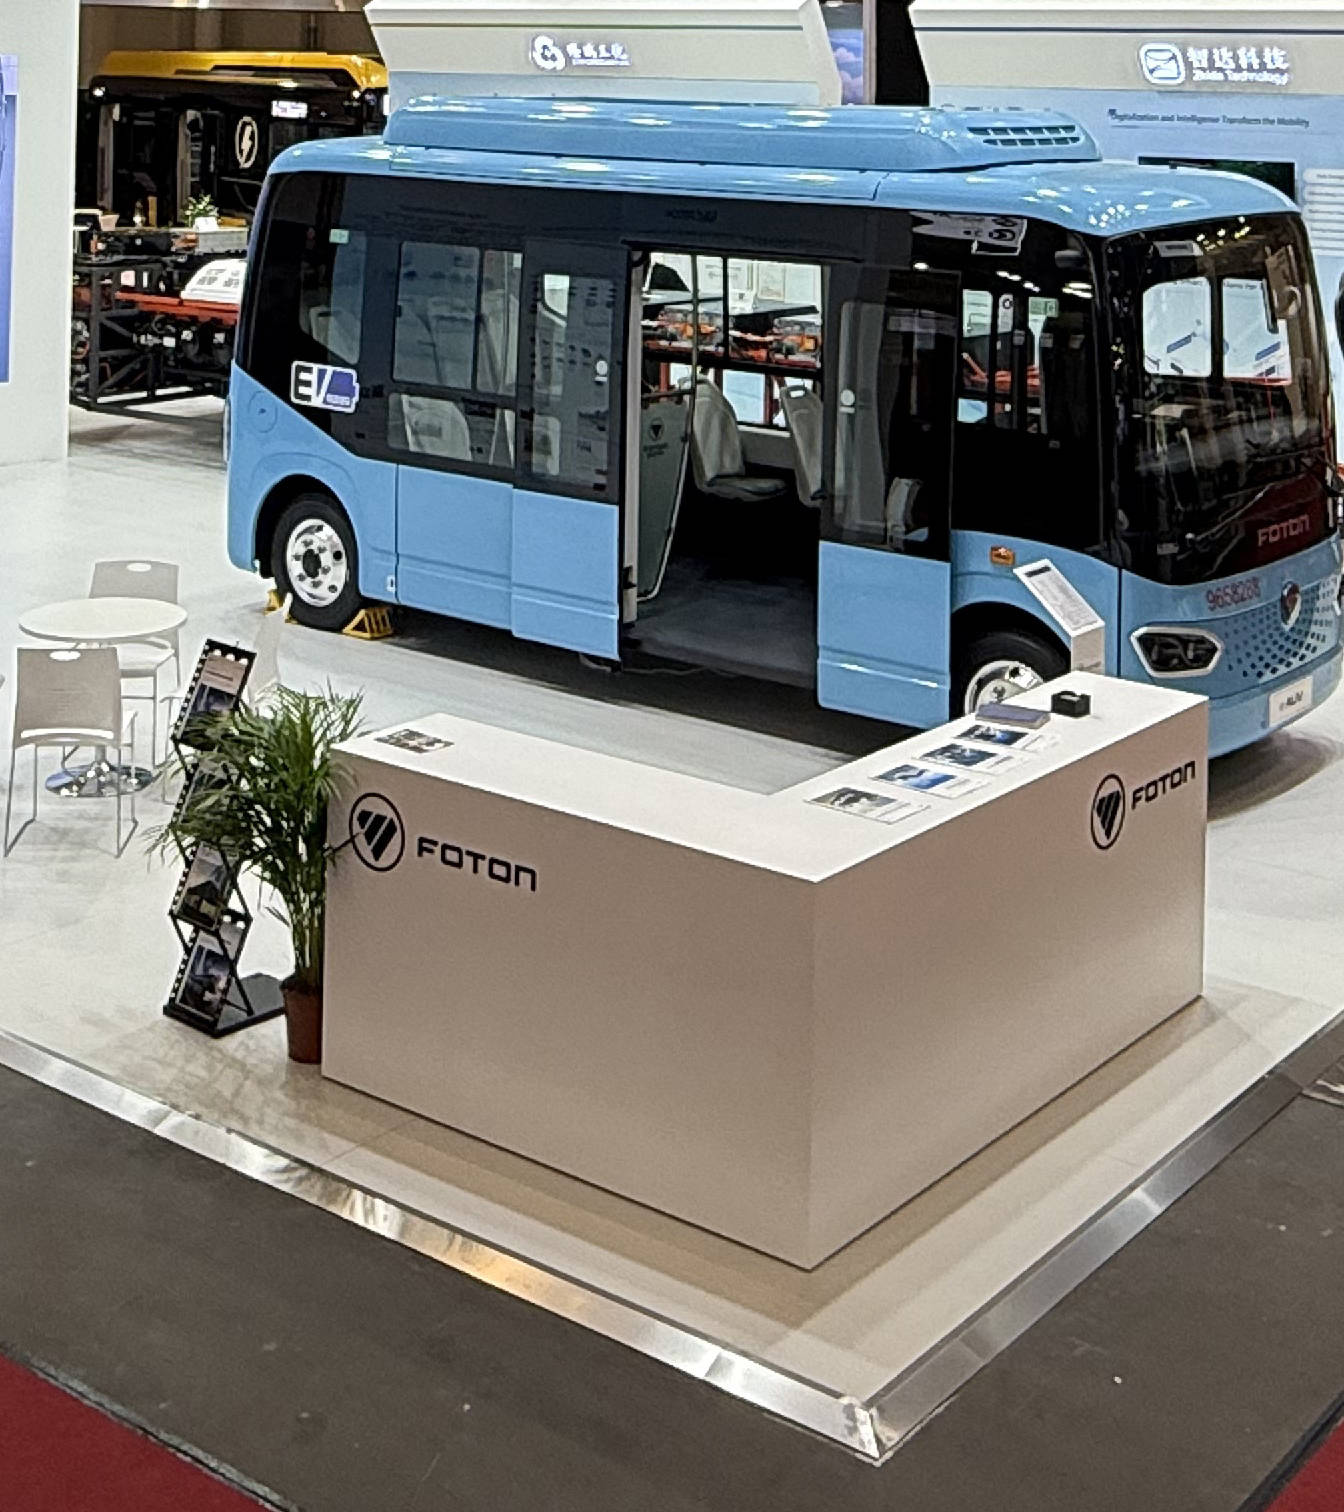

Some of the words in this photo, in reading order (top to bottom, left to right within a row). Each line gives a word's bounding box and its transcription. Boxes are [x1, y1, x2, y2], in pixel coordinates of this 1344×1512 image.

[1257, 514, 1310, 547] FOTON
[1131, 760, 1196, 810] FOTON
[417, 836, 538, 892] FOTON
